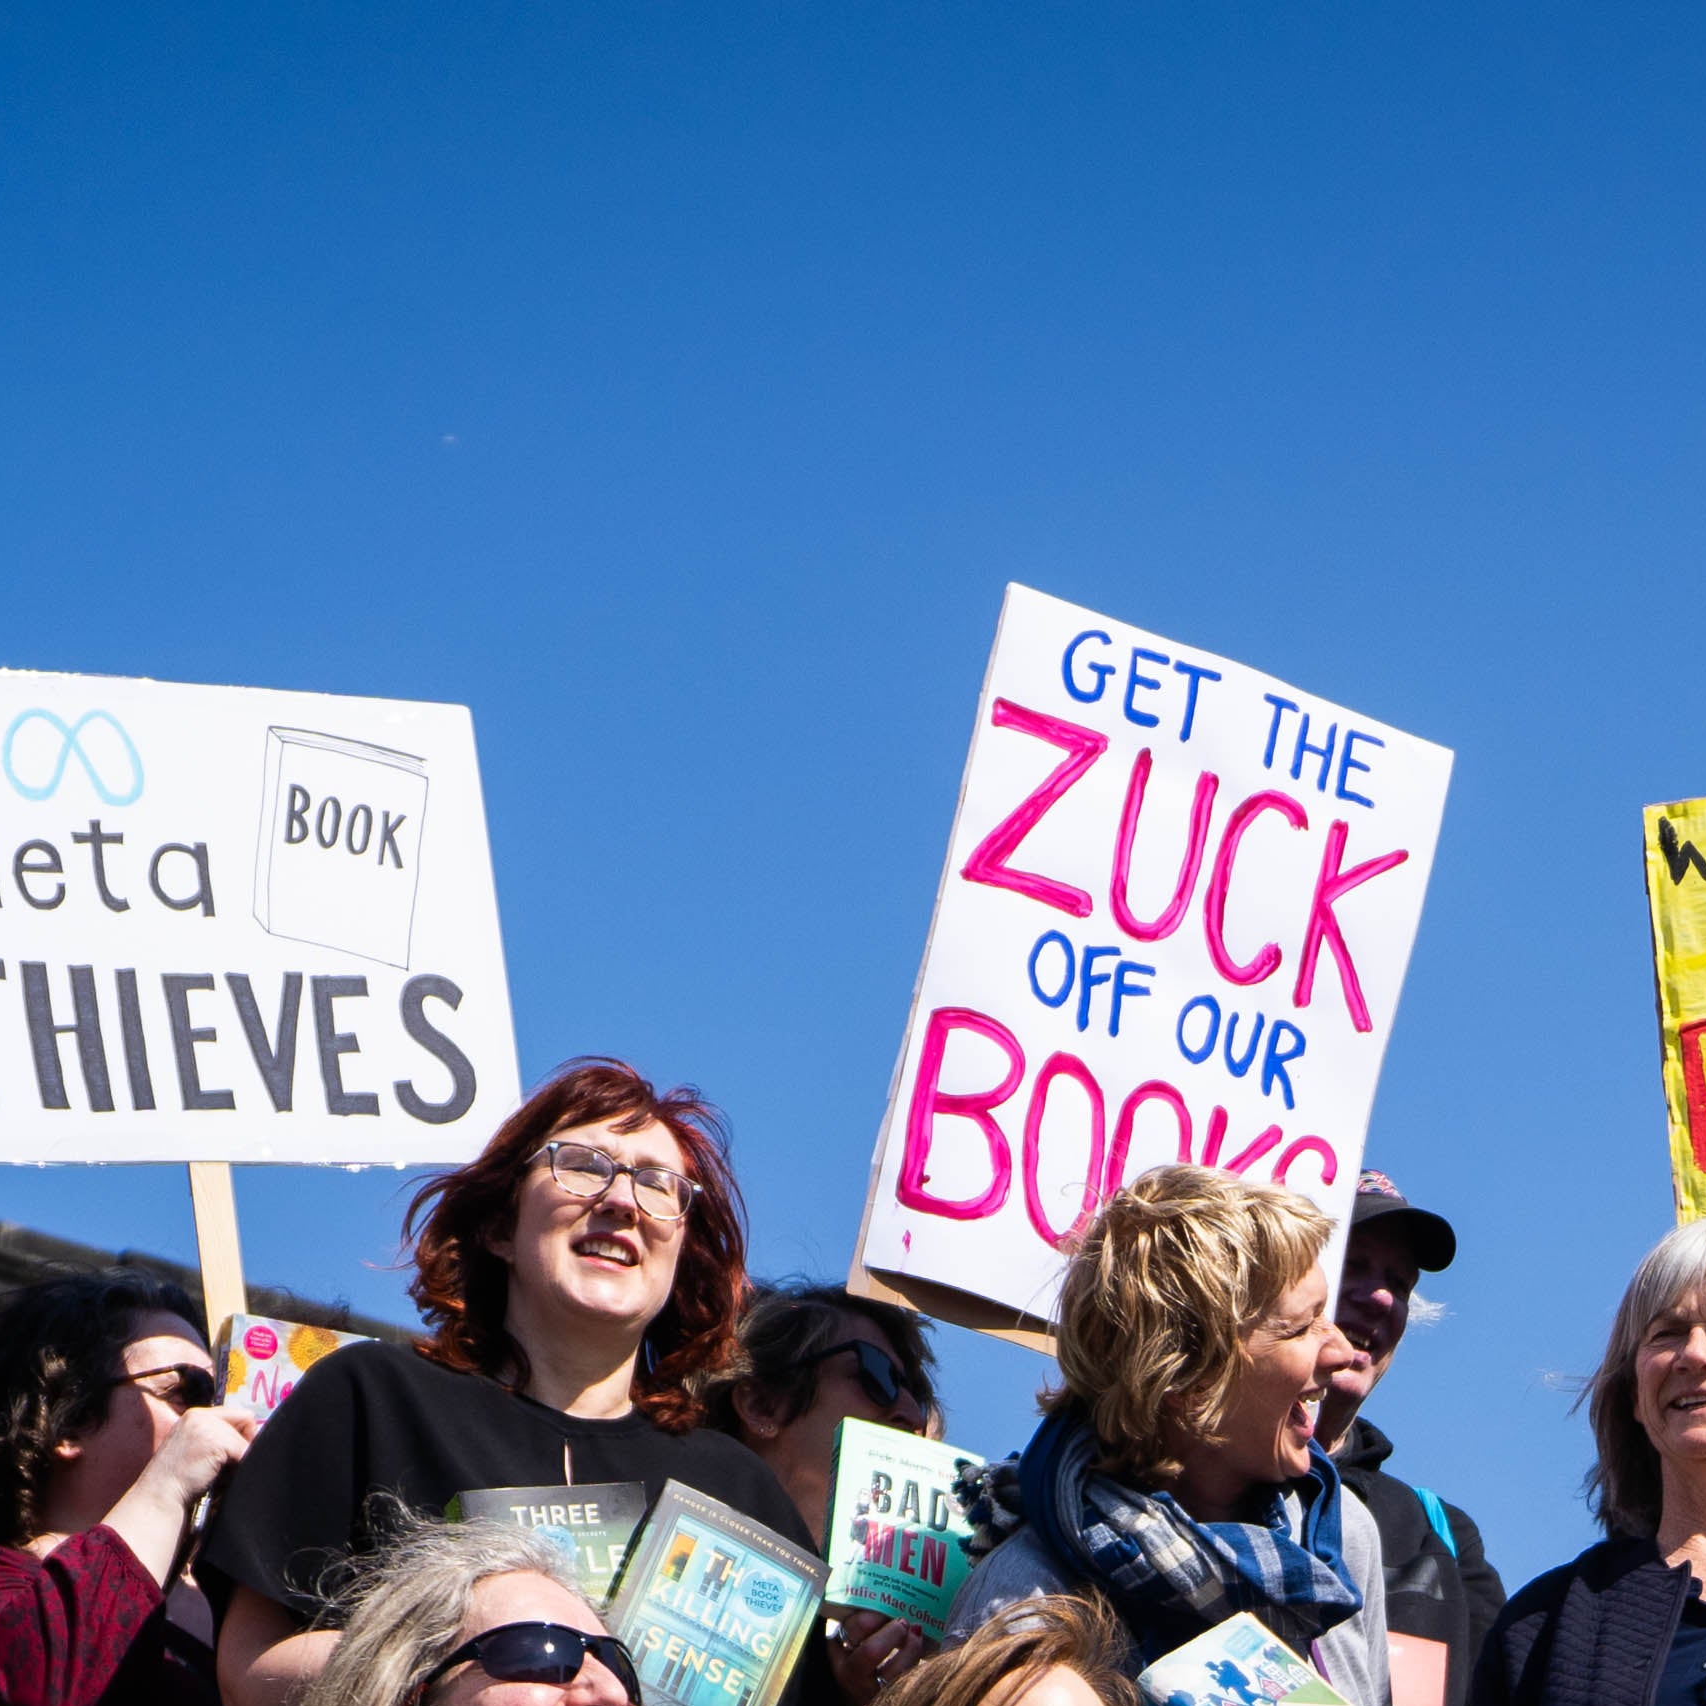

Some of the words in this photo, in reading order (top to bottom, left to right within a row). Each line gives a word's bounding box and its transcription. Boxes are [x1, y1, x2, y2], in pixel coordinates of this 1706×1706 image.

[1062, 629, 1221, 742] GET
[1264, 692, 1385, 809] THE
[283, 783, 408, 869] BOOK
[961, 696, 1409, 1034] ZUCK
[1027, 929, 1157, 1037] OFF
[1175, 994, 1306, 1110] OUR
[509, 1503, 601, 1527] THREE
[871, 1470, 950, 1532] BAD
[719, 1515, 751, 1536] CLOSER
[752, 1532, 774, 1548] THAN
[775, 1546, 792, 1560] YOU
[864, 1519, 949, 1588] MEN
[706, 1548, 745, 1590] TH
[751, 1589, 780, 1602] BOOK
[752, 1579, 780, 1593] META
[650, 1578, 776, 1660] KILLING
[744, 1597, 784, 1614] THIEVES
[879, 1593, 907, 1613] Mae
[642, 1625, 747, 1697] SENSE
